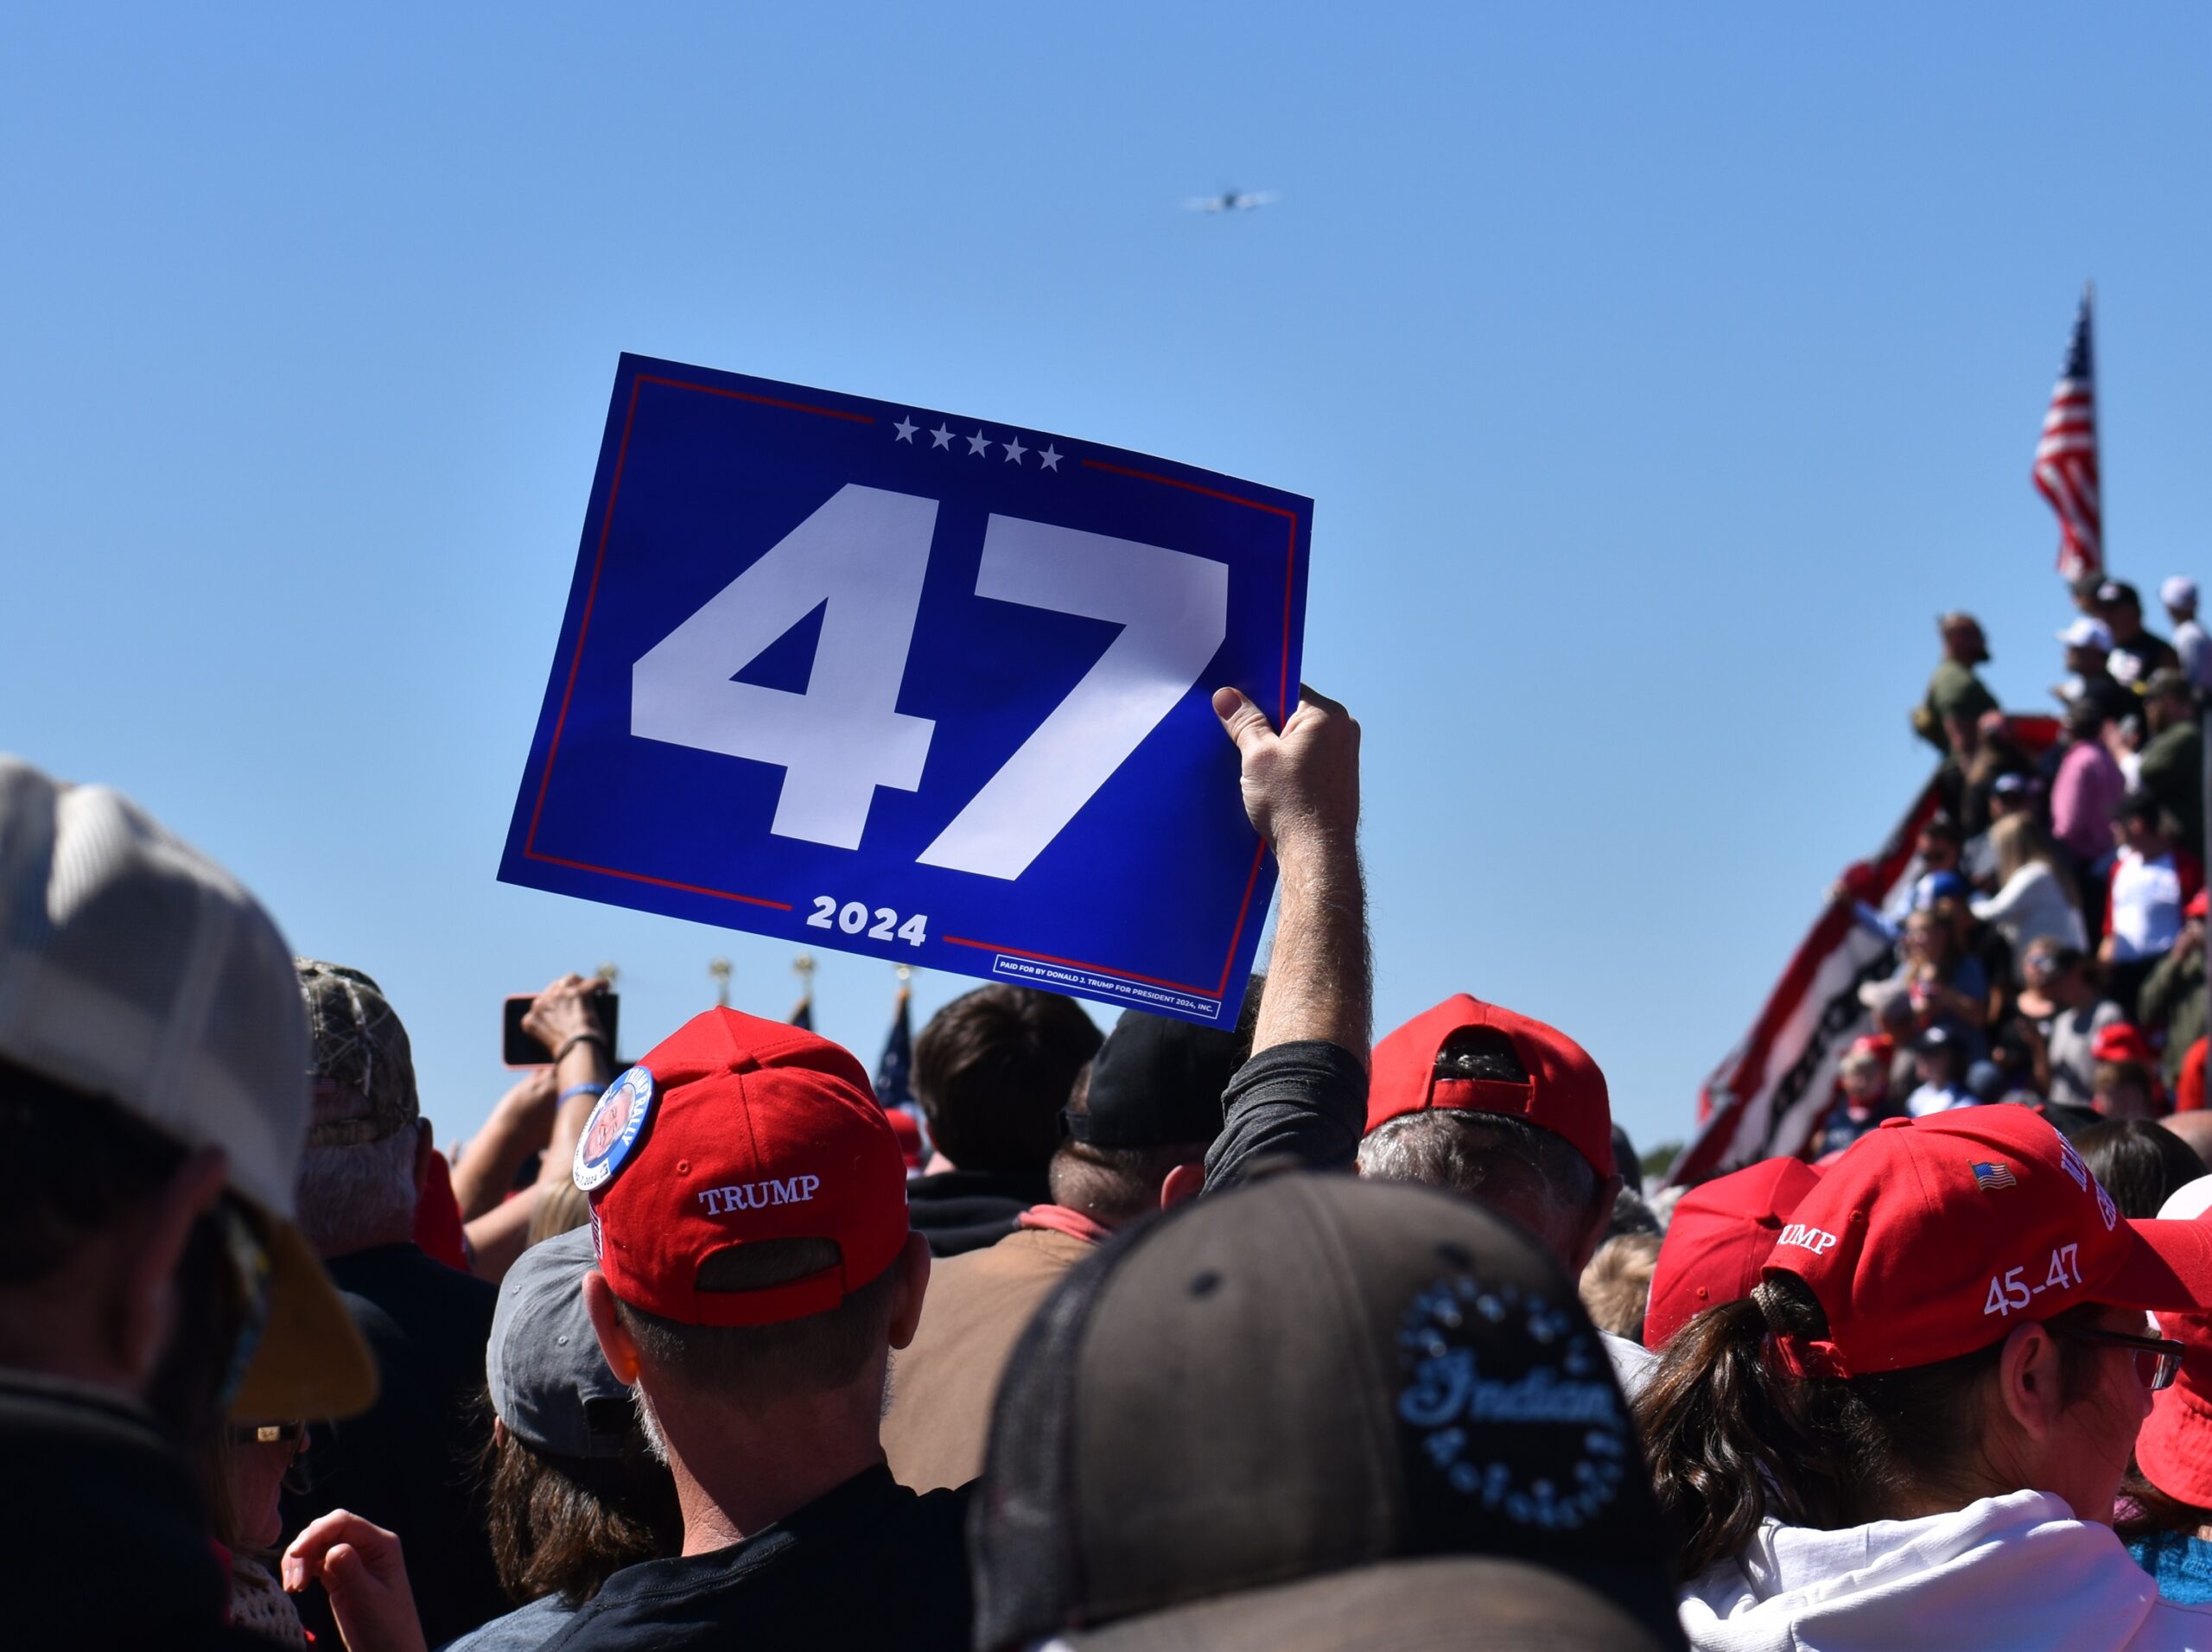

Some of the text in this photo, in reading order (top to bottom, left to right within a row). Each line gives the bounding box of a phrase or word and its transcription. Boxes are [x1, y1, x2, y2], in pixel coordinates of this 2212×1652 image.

[631, 483, 1229, 880] 47
[806, 895, 928, 947] 2024
[1000, 961, 1018, 970] PAID
[1019, 964, 1035, 975] FOR
[1035, 968, 1046, 976] BY
[1046, 970, 1079, 982] DONALD
[1087, 978, 1115, 990] TRUMP
[1115, 984, 1132, 994] FOR
[1132, 988, 1175, 1003] PRESIDENT
[1175, 998, 1197, 1010] 2024,
[1198, 1002, 1214, 1013] INC.
[621, 1068, 648, 1147] TRUMP RALLY
[698, 1175, 820, 1216] TRUMP
[1777, 1223, 1837, 1255] UMP
[1984, 1242, 2082, 1317] 45-47
